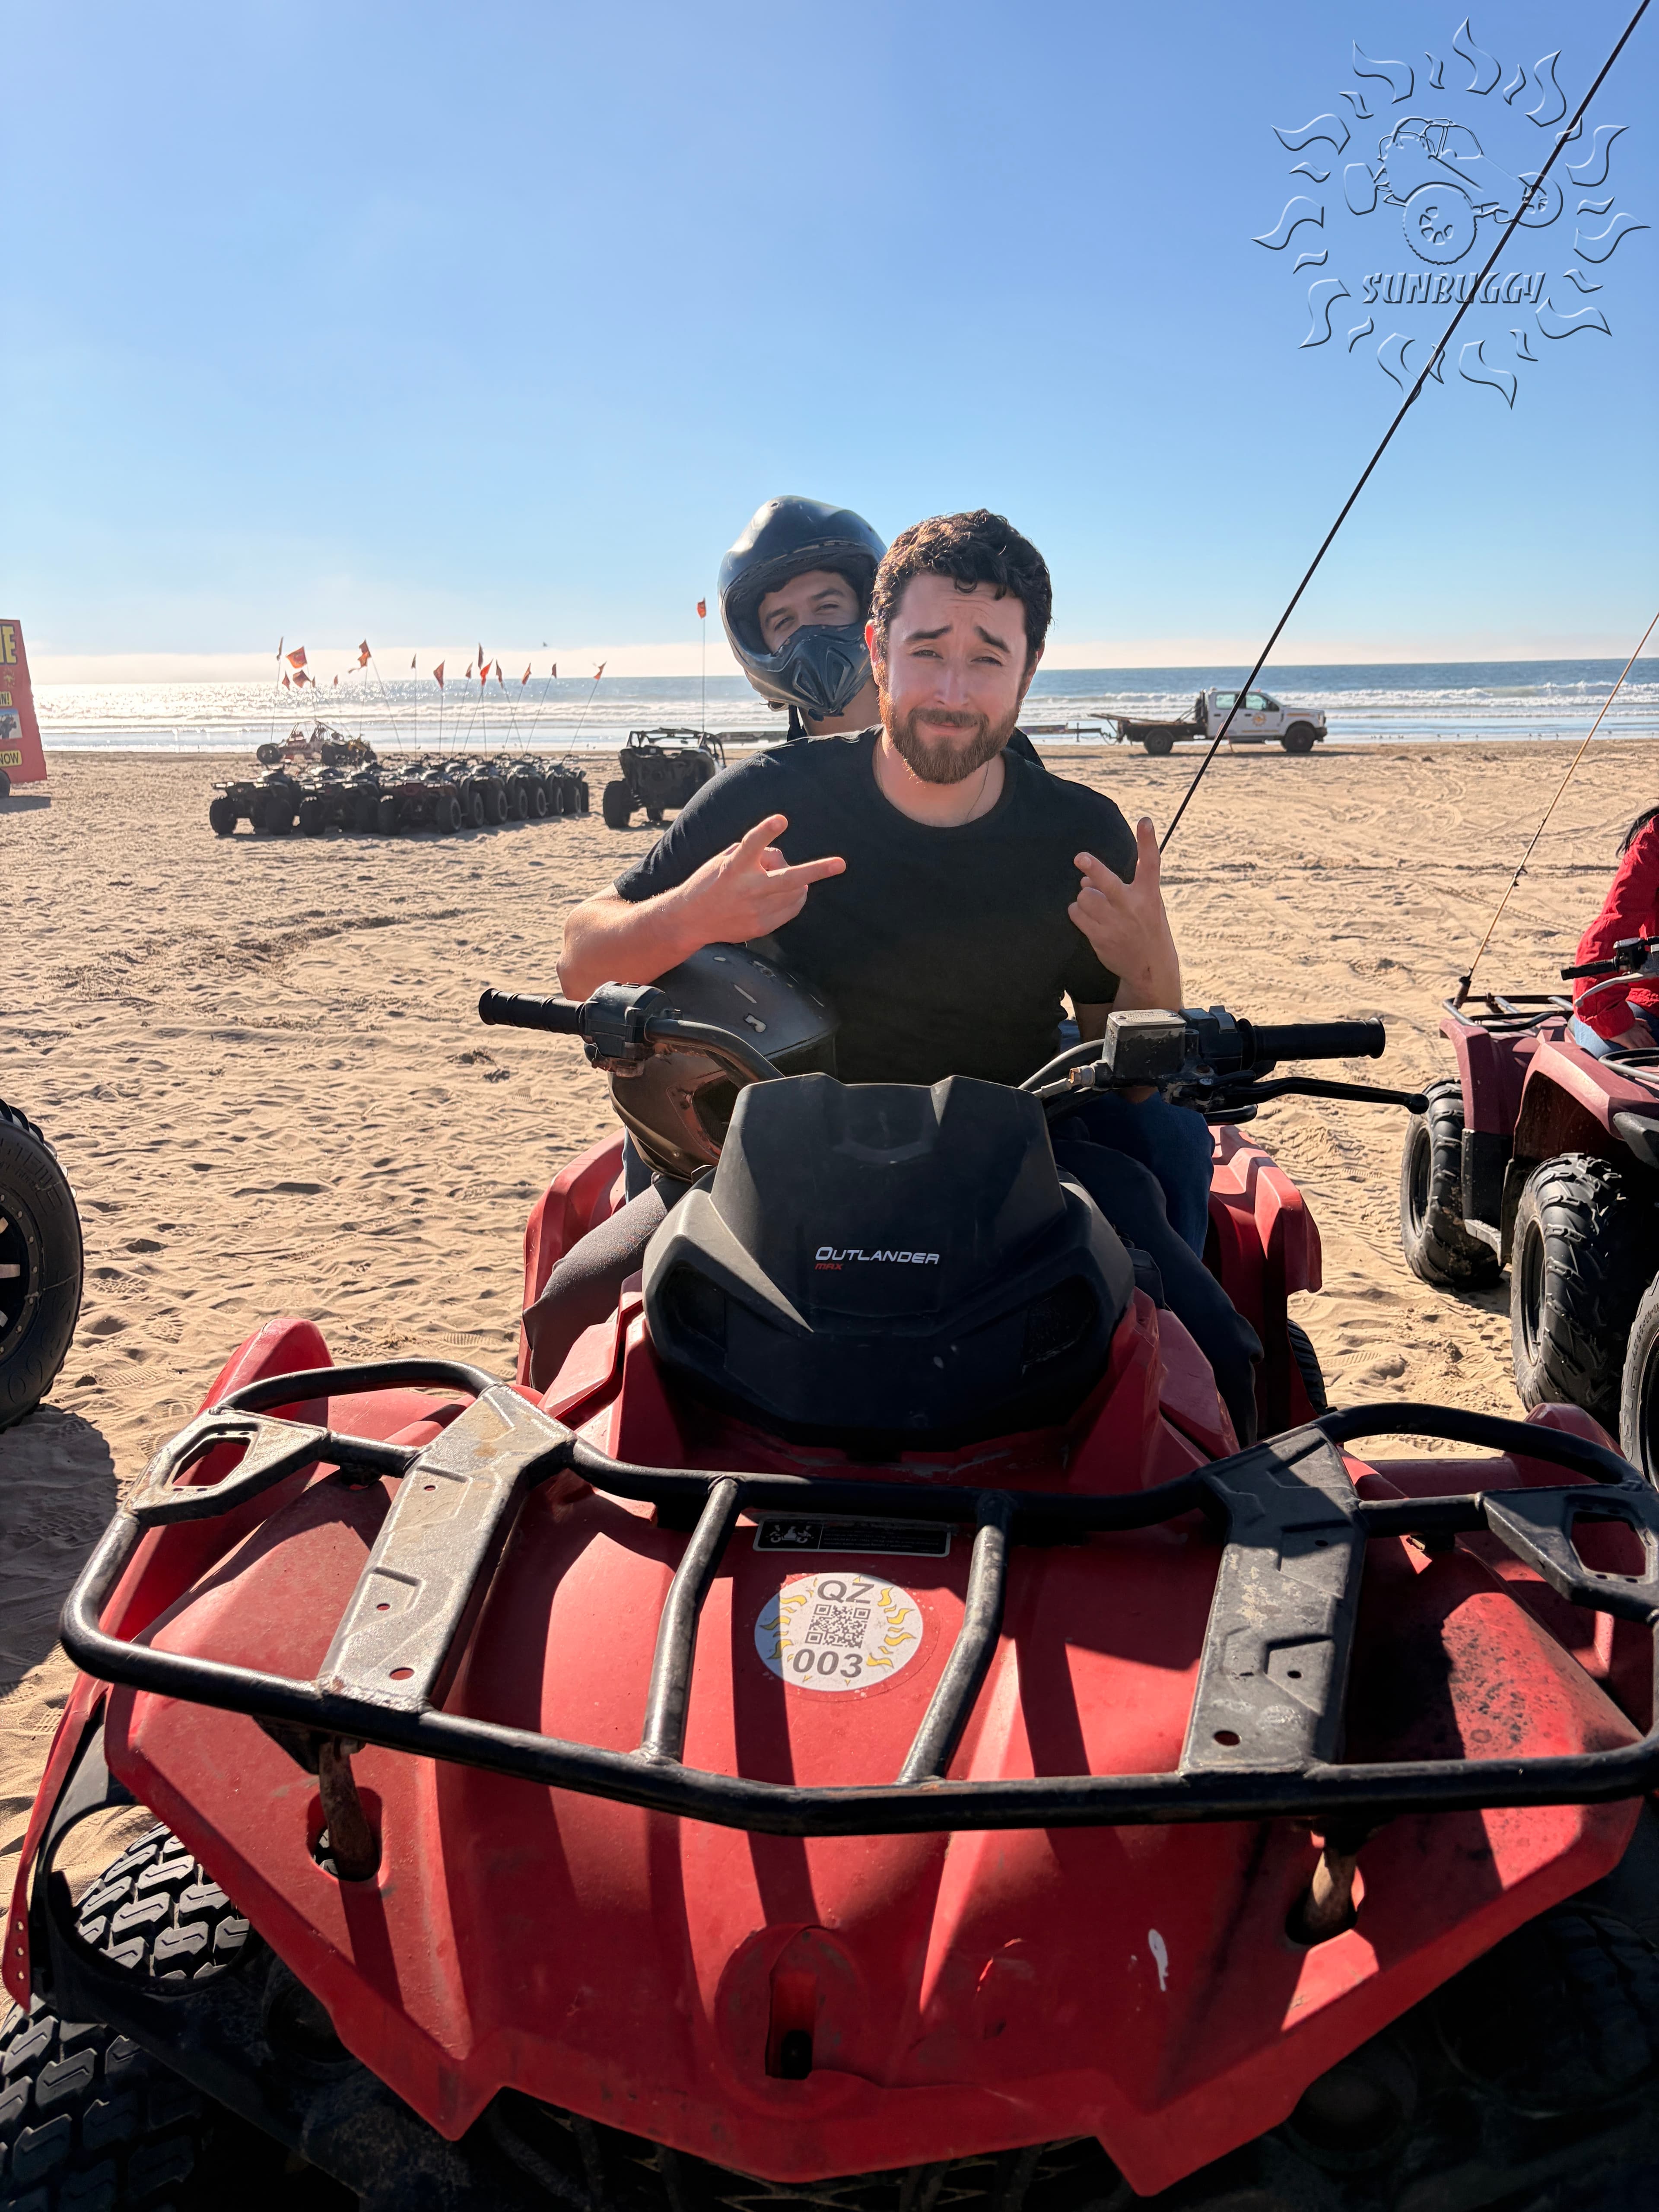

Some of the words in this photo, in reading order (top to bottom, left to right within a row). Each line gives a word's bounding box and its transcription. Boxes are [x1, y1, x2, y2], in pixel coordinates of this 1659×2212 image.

[0, 624, 17, 664] E
[815, 1246, 940, 1265] OUTLANDER
[817, 1580, 874, 1604] QZ
[793, 1649, 863, 1678] 003
